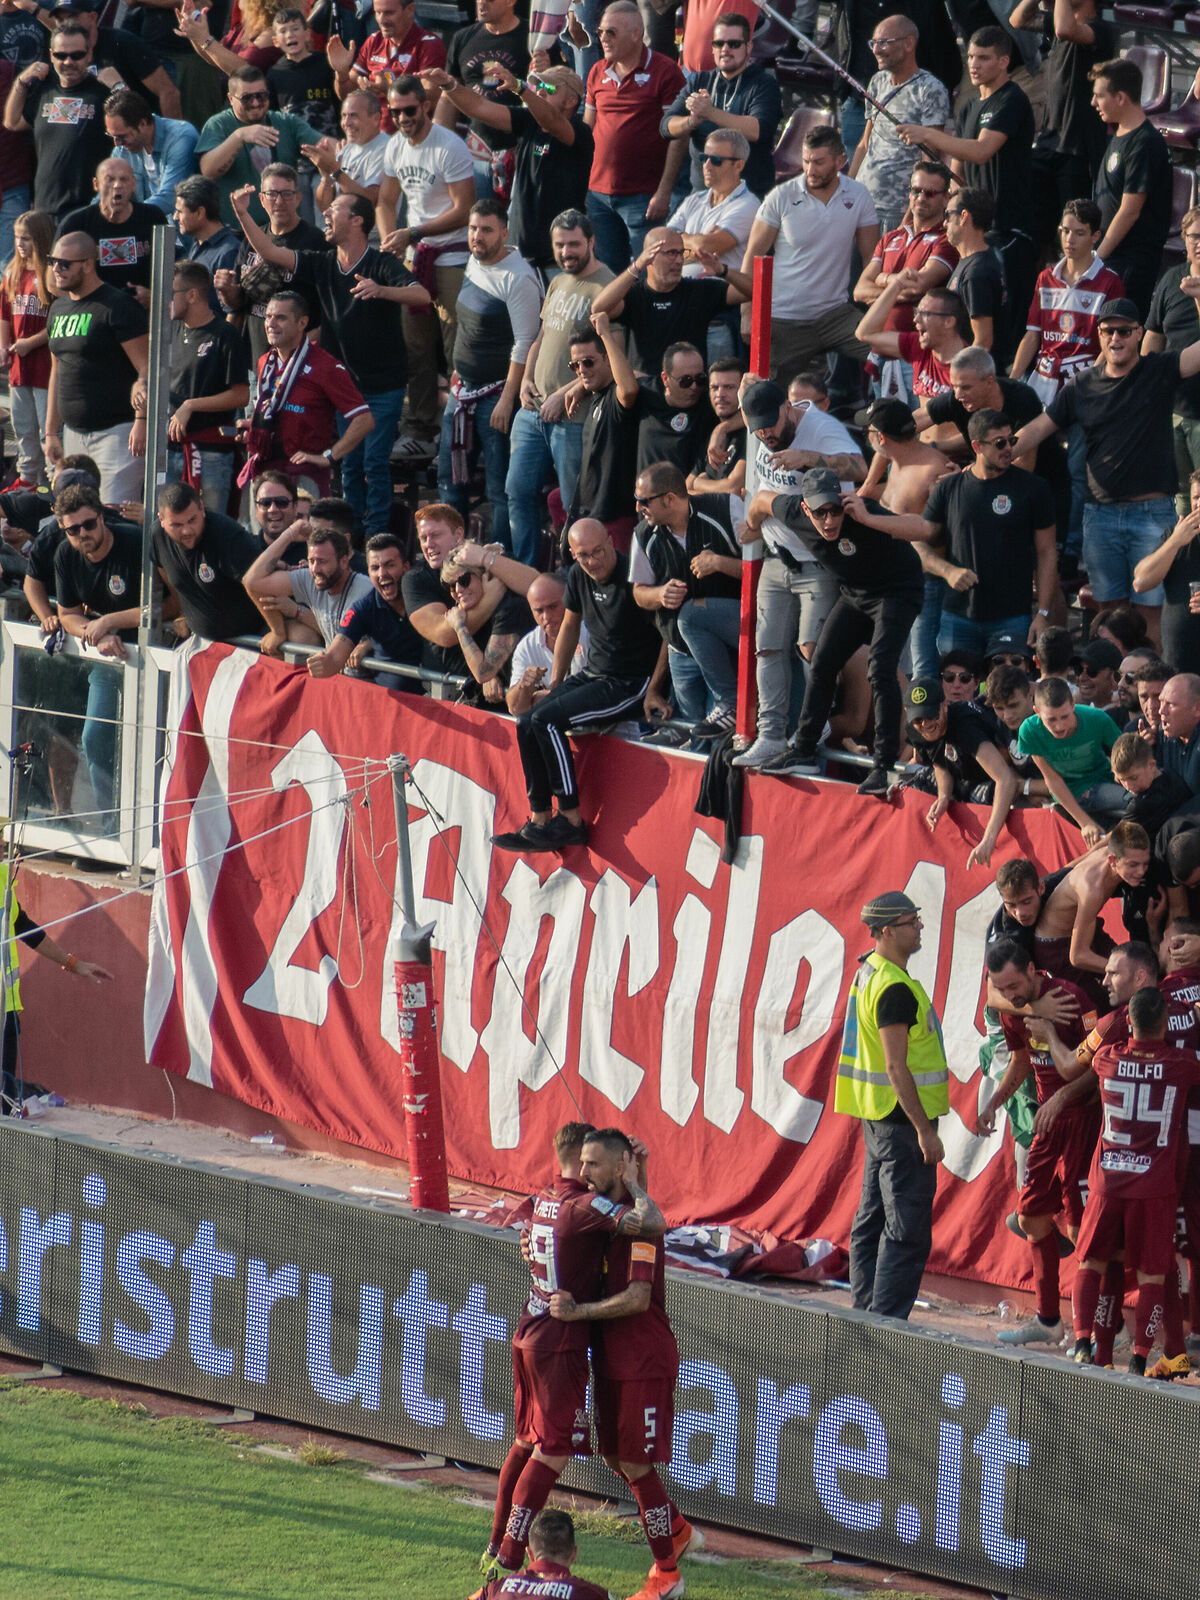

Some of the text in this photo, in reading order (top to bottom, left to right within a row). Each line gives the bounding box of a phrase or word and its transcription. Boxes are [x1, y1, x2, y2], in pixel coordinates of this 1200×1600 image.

[381, 756, 846, 1152] Aprile
[1117, 1060, 1163, 1080] GOLFO
[1101, 1079, 1178, 1147] 24
[644, 1407, 657, 1439] 5
[500, 1577, 573, 1599] PETTINARI
